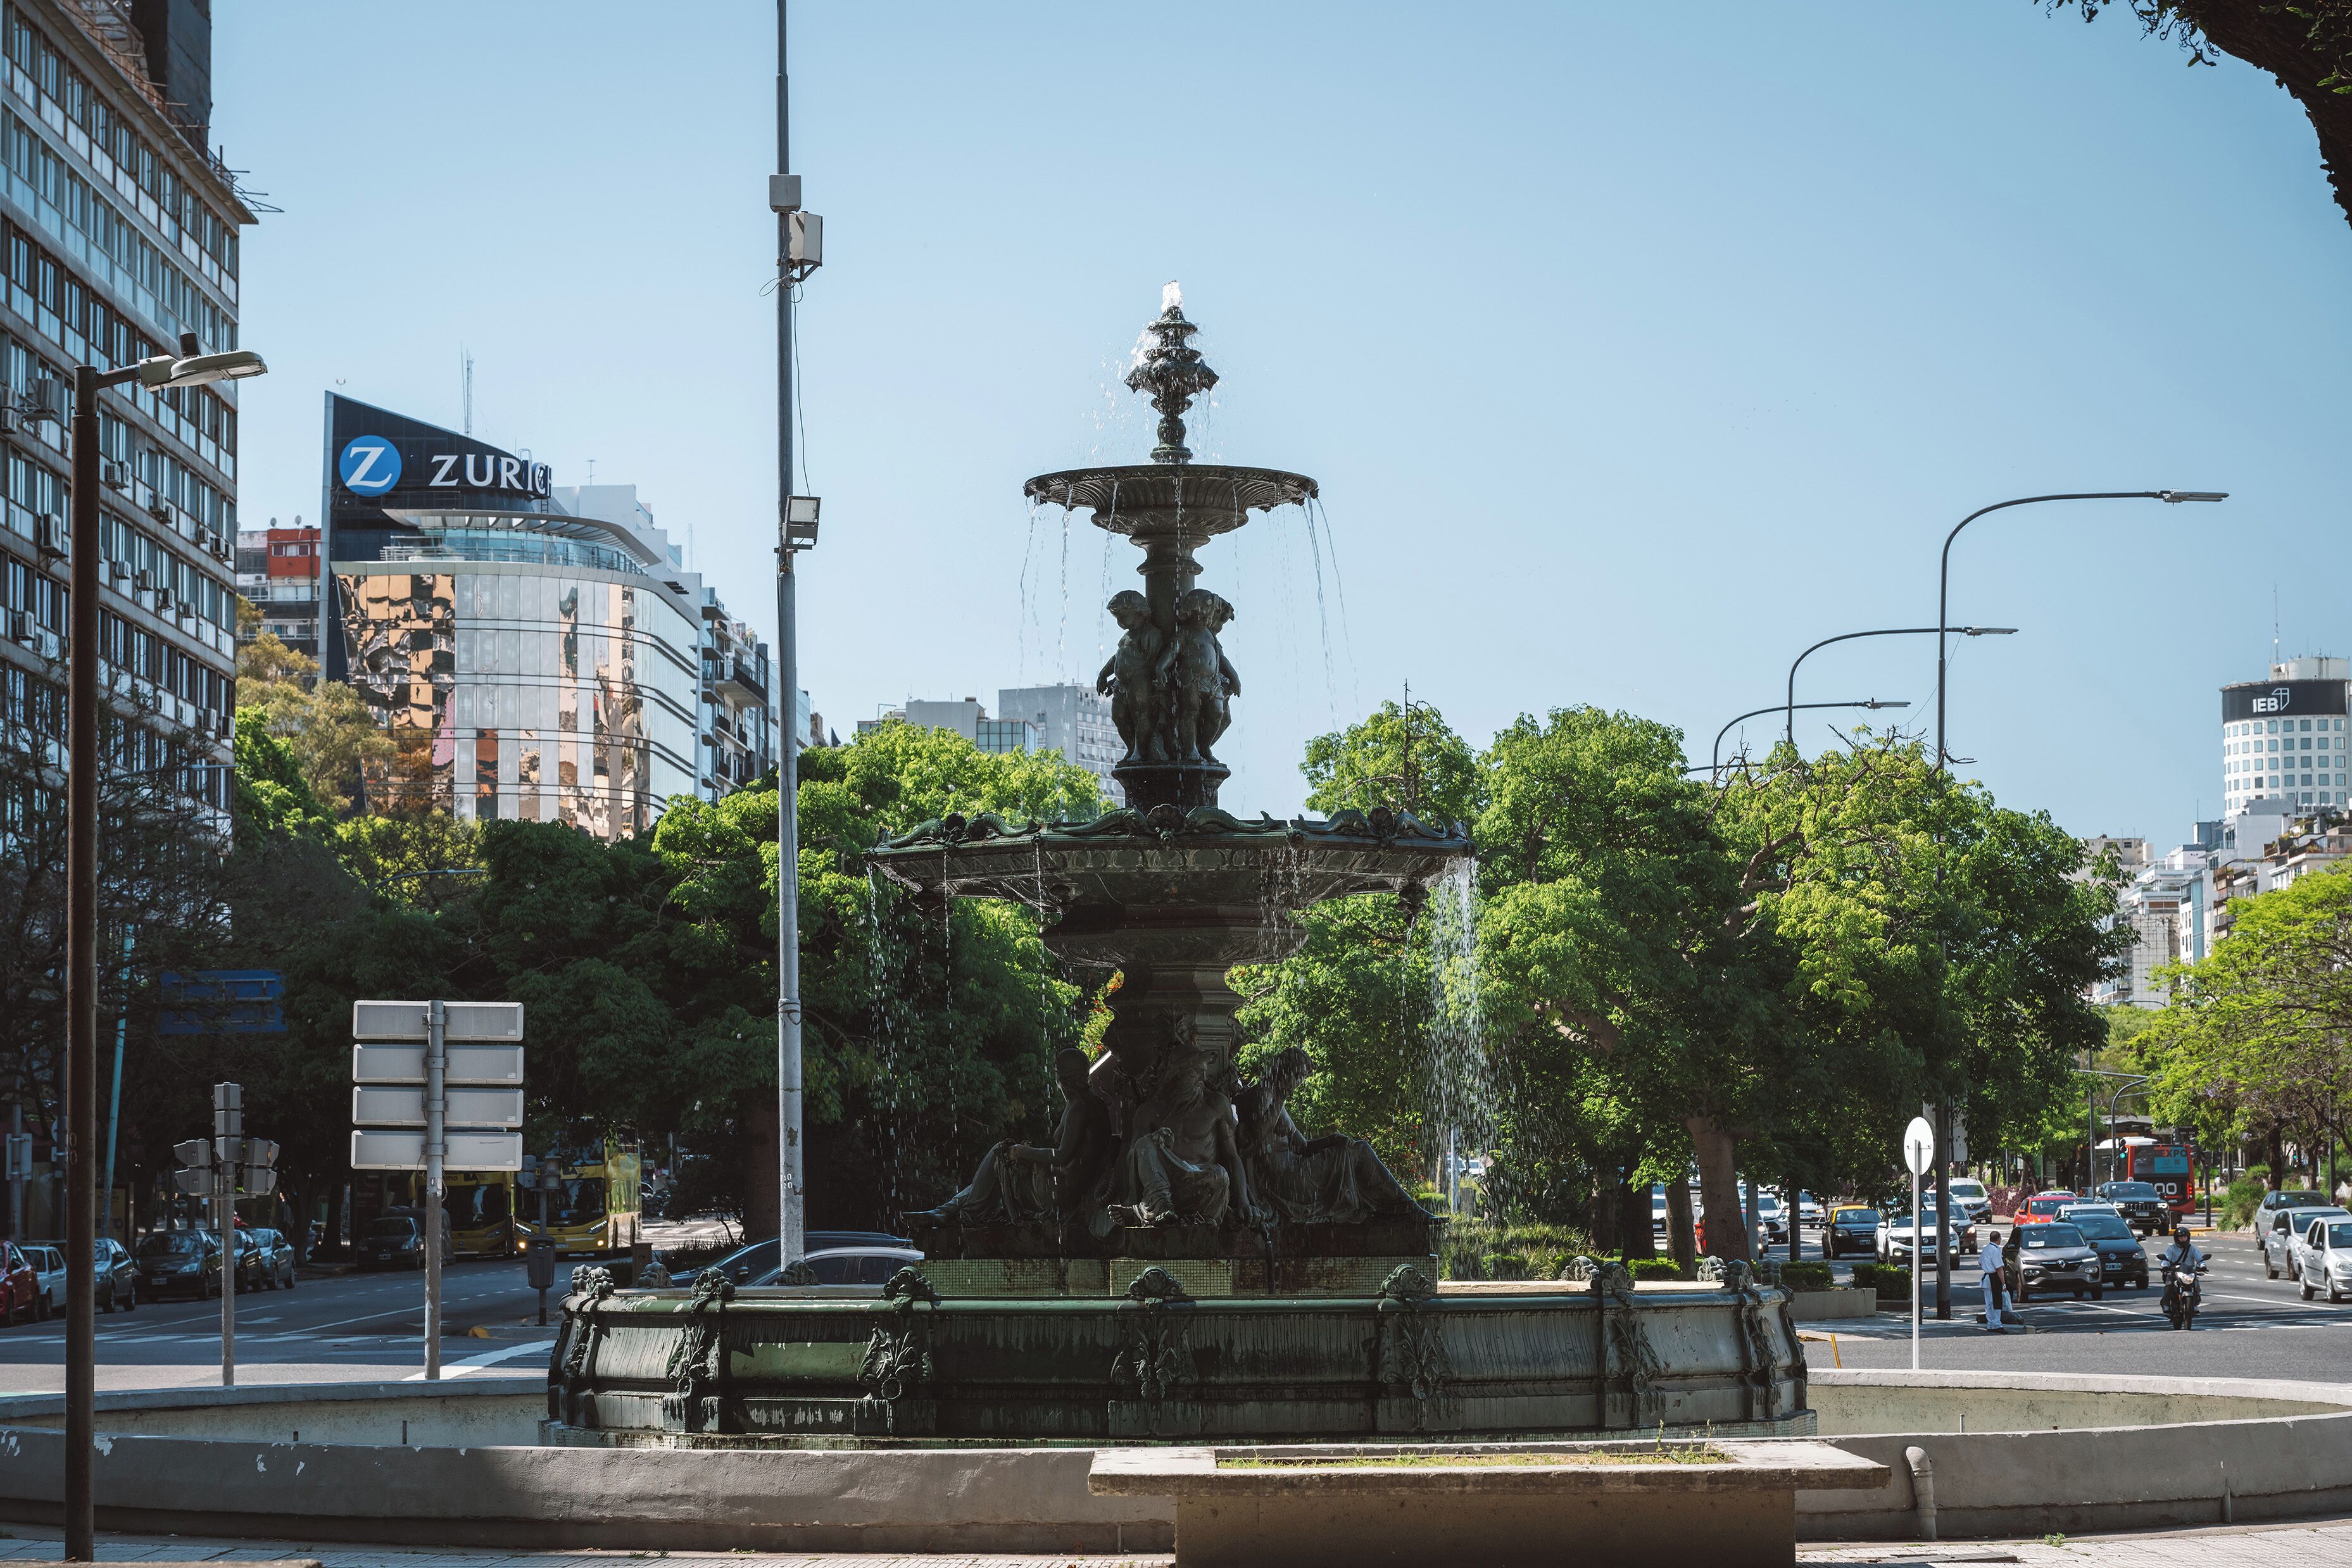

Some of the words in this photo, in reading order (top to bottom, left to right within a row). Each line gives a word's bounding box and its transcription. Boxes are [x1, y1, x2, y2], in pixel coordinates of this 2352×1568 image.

[345, 447, 392, 487] Z
[429, 454, 552, 498] ZURICH
[2253, 698, 2279, 713] IEB
[783, 1173, 792, 1181] 10
[783, 1181, 793, 1189] 20
